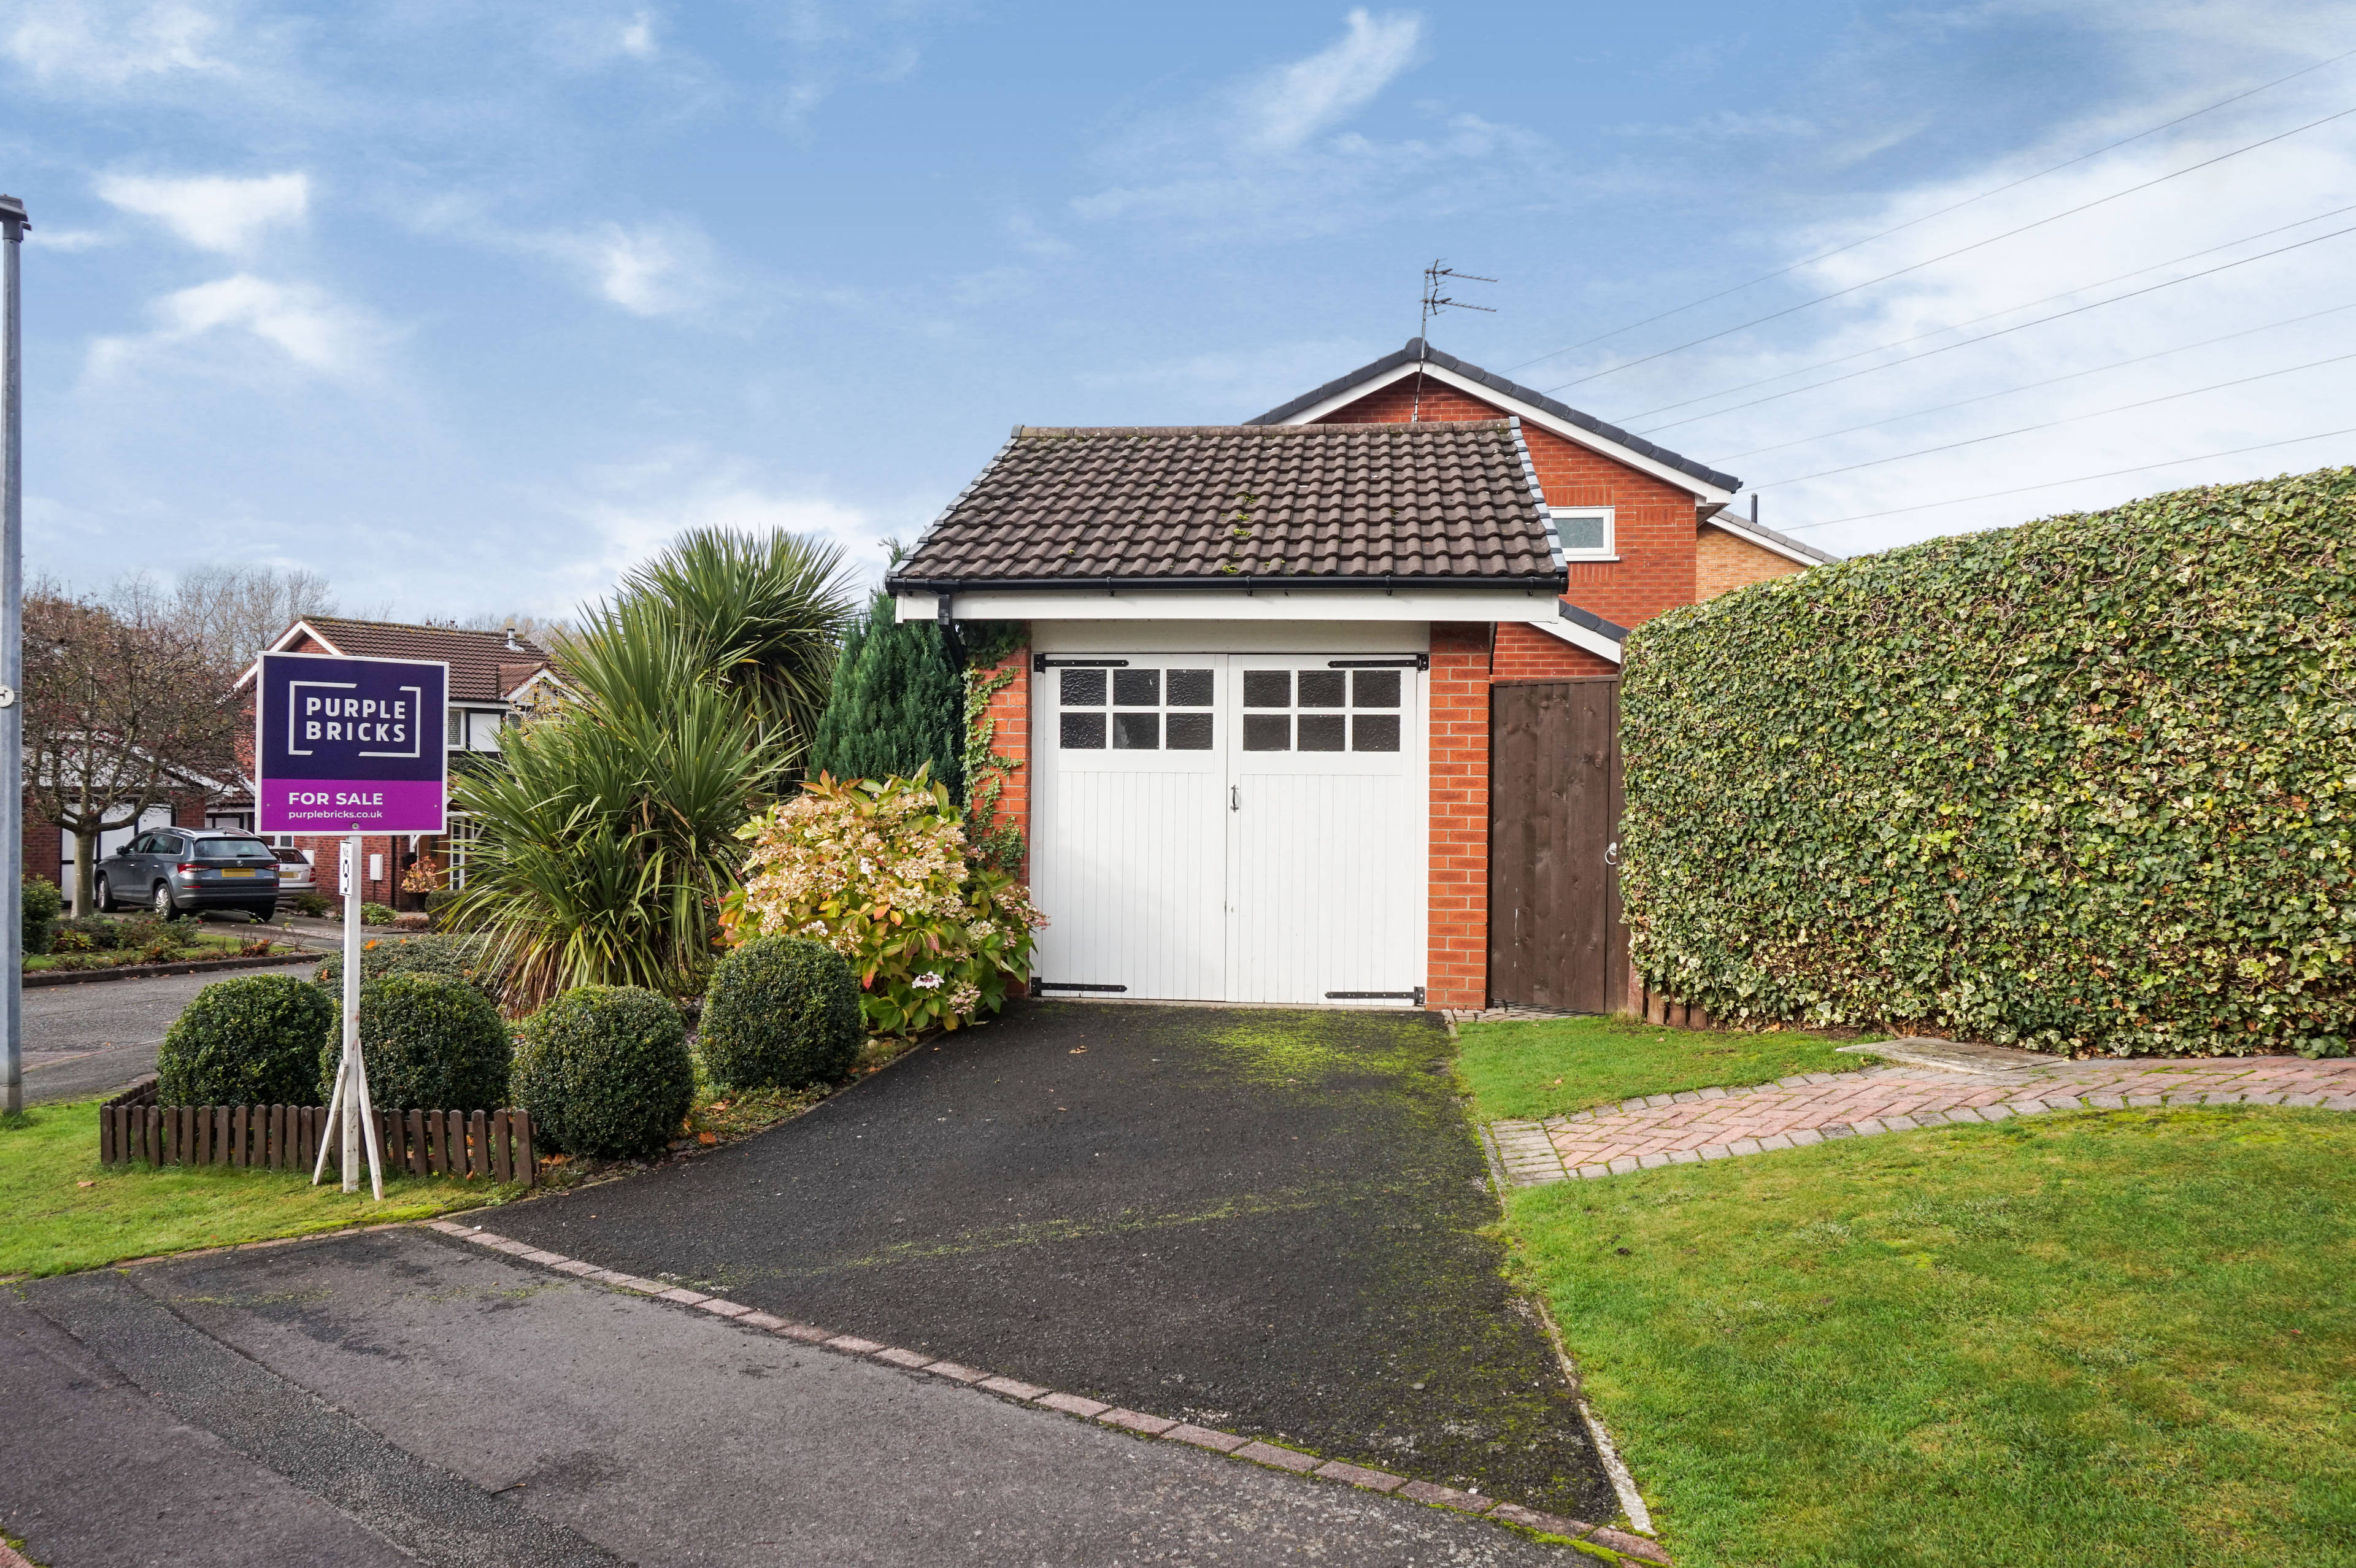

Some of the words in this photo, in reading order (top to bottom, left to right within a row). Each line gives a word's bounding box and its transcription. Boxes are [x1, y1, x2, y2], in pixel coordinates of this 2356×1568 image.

[306, 697, 406, 720] PURPLE
[306, 721, 406, 742] BRICKS
[288, 792, 329, 805] FOR
[336, 793, 383, 805] SALE
[288, 810, 383, 820] purplebricks.co.uk
